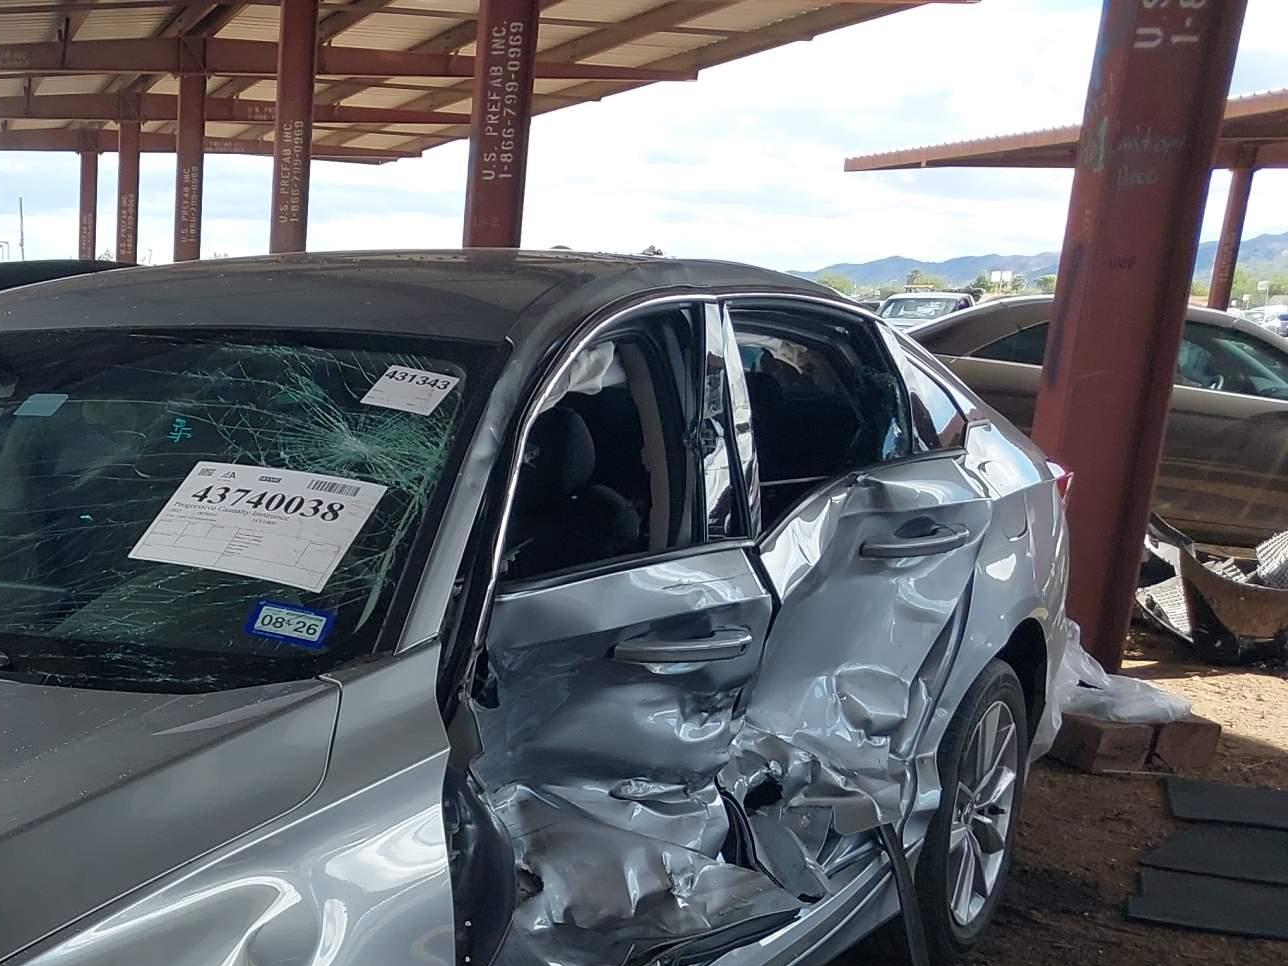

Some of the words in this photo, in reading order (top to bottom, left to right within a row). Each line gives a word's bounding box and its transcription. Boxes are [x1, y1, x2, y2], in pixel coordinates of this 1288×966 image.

[491, 20, 506, 55] INC.
[485, 65, 503, 135] PREFAB
[498, 21, 524, 178] 1-866-799-0969
[482, 146, 498, 180] U.S.
[385, 370, 451, 390] 431343
[192, 485, 345, 522] 43740038
[260, 614, 285, 629] 08
[293, 620, 319, 636] 26
